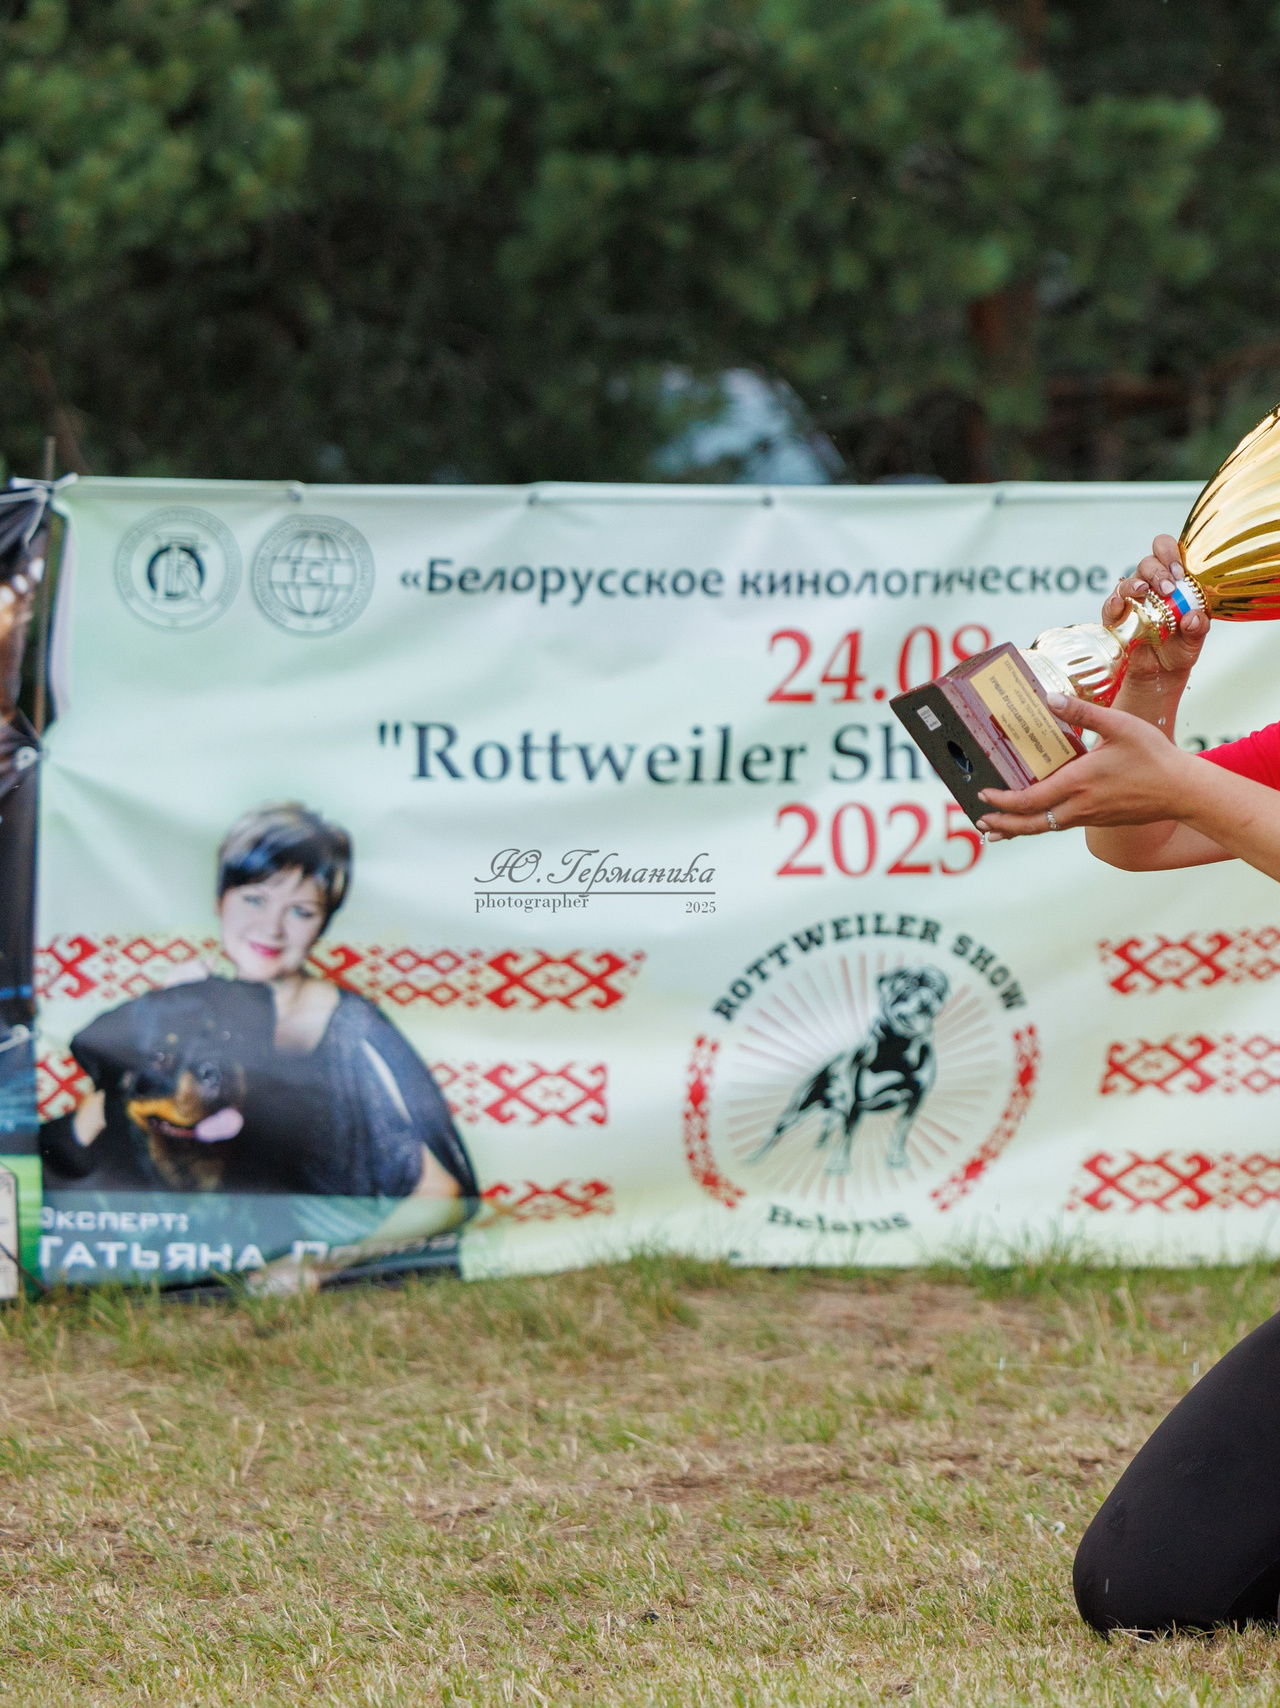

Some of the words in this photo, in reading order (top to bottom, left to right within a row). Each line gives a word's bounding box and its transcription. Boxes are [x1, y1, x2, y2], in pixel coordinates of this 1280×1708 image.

[400, 557, 724, 606] «Белорусское
[739, 564, 1110, 599] кинологическое
[377, 721, 808, 784] "Rottweiler
[830, 722, 944, 783] Sh
[775, 801, 986, 877] 2025
[712, 913, 942, 1022] ROTTWEILER
[951, 932, 1026, 1012] SHOW
[766, 1204, 911, 1234] Belarus
